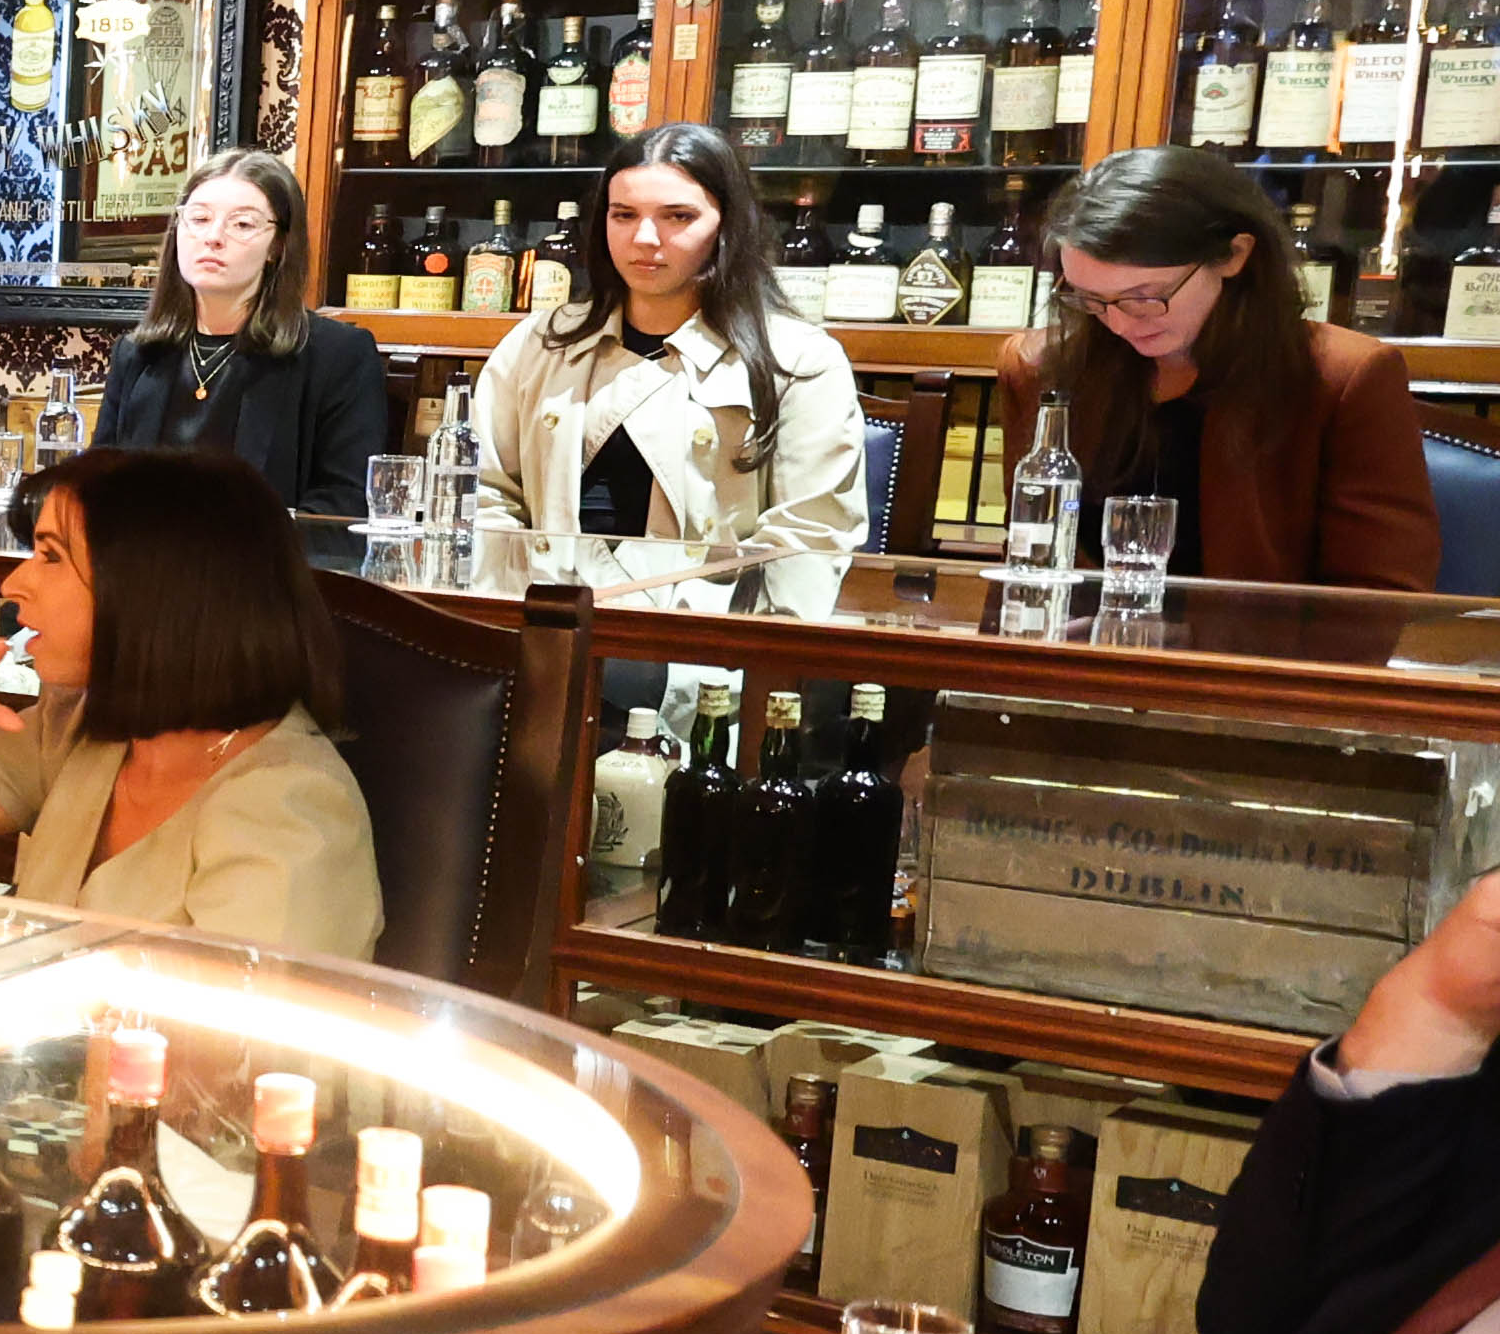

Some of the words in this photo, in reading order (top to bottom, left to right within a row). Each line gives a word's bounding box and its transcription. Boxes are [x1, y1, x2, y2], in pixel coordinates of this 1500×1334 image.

[90, 18, 133, 33] 1815
[36, 81, 177, 169] WHISKY
[1071, 867, 1245, 905] DUBLIN
